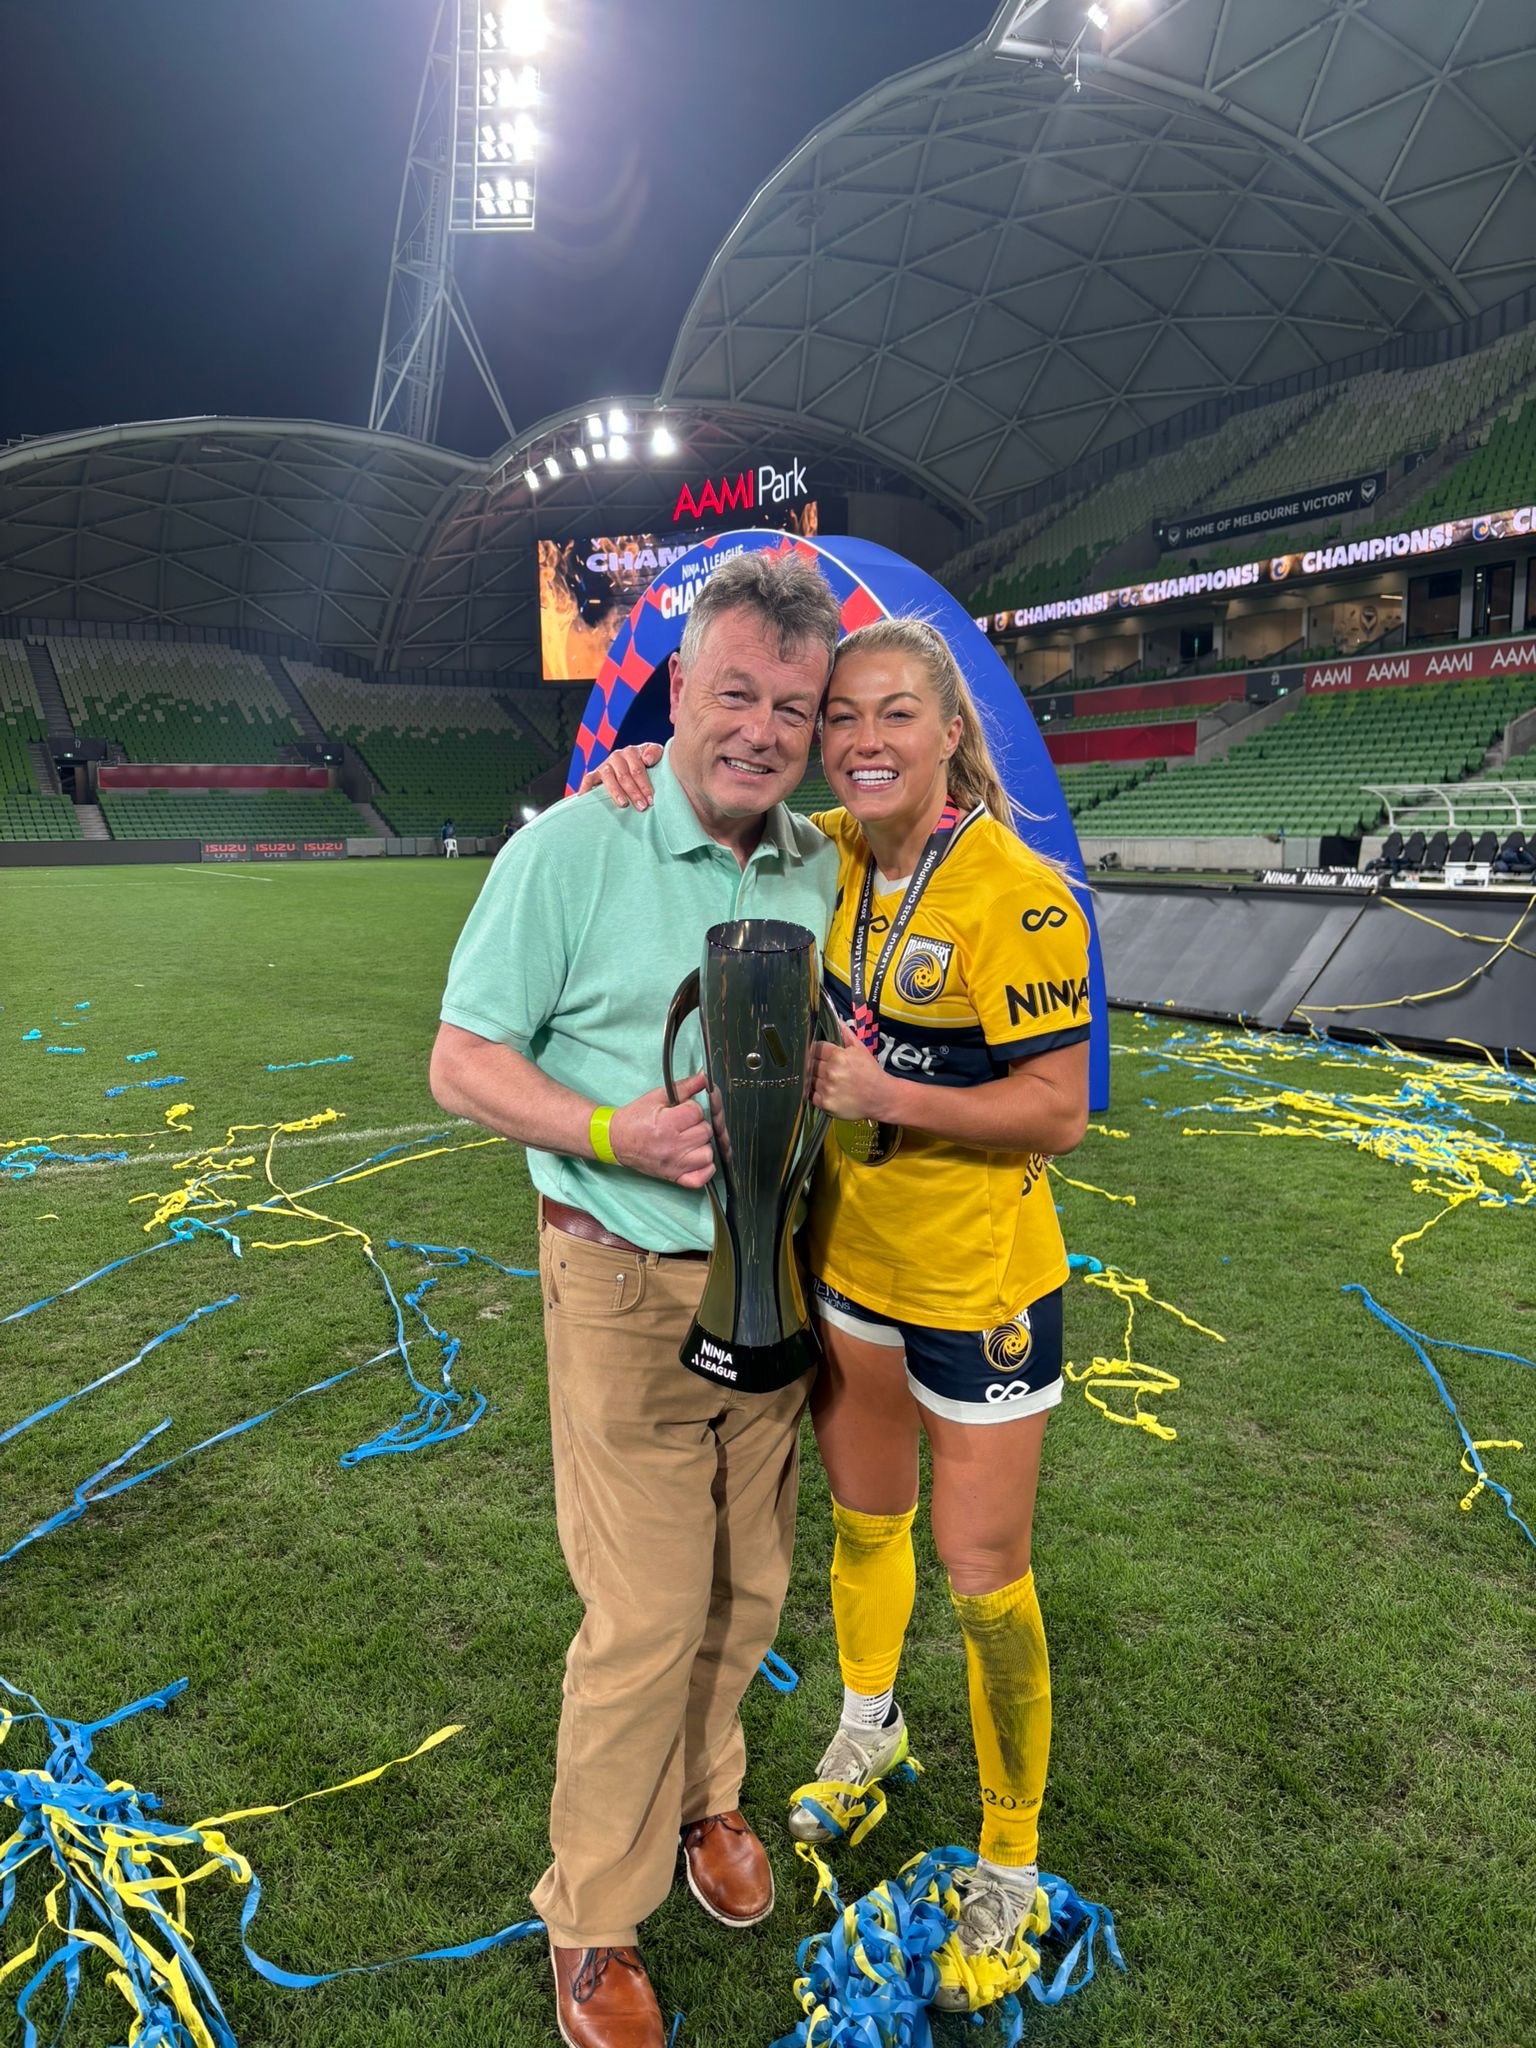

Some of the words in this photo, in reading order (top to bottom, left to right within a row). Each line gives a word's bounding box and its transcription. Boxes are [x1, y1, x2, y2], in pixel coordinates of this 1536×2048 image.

[672, 468, 754, 521] AAMI
[758, 456, 808, 506] Park
[1186, 524, 1215, 540] HOME
[1216, 519, 1231, 533] OF
[1233, 503, 1299, 529] MELBOURNE
[1302, 489, 1354, 513] VICTORY
[1302, 523, 1453, 574] CHAMPIONS!
[1142, 562, 1260, 604] CHAMPIONS!
[1014, 593, 1109, 628] CHAMPIONS!
[1425, 651, 1473, 677] AAMI
[1490, 644, 1536, 669] AAM
[1311, 665, 1352, 689] AAMI
[1366, 659, 1410, 683] AAMI
[205, 843, 247, 853] ISUZU
[255, 842, 296, 852] ISUZU
[304, 842, 343, 851] ISUZU
[881, 932, 899, 969] LEAGUE
[896, 904, 911, 927] 2025
[908, 849, 938, 904] CHAMPIONS
[855, 925, 865, 960] LEAGUE
[1004, 976, 1089, 1027] NINJA
[700, 1338, 733, 1366] NINJA
[699, 1357, 738, 1381] LEAGUE
